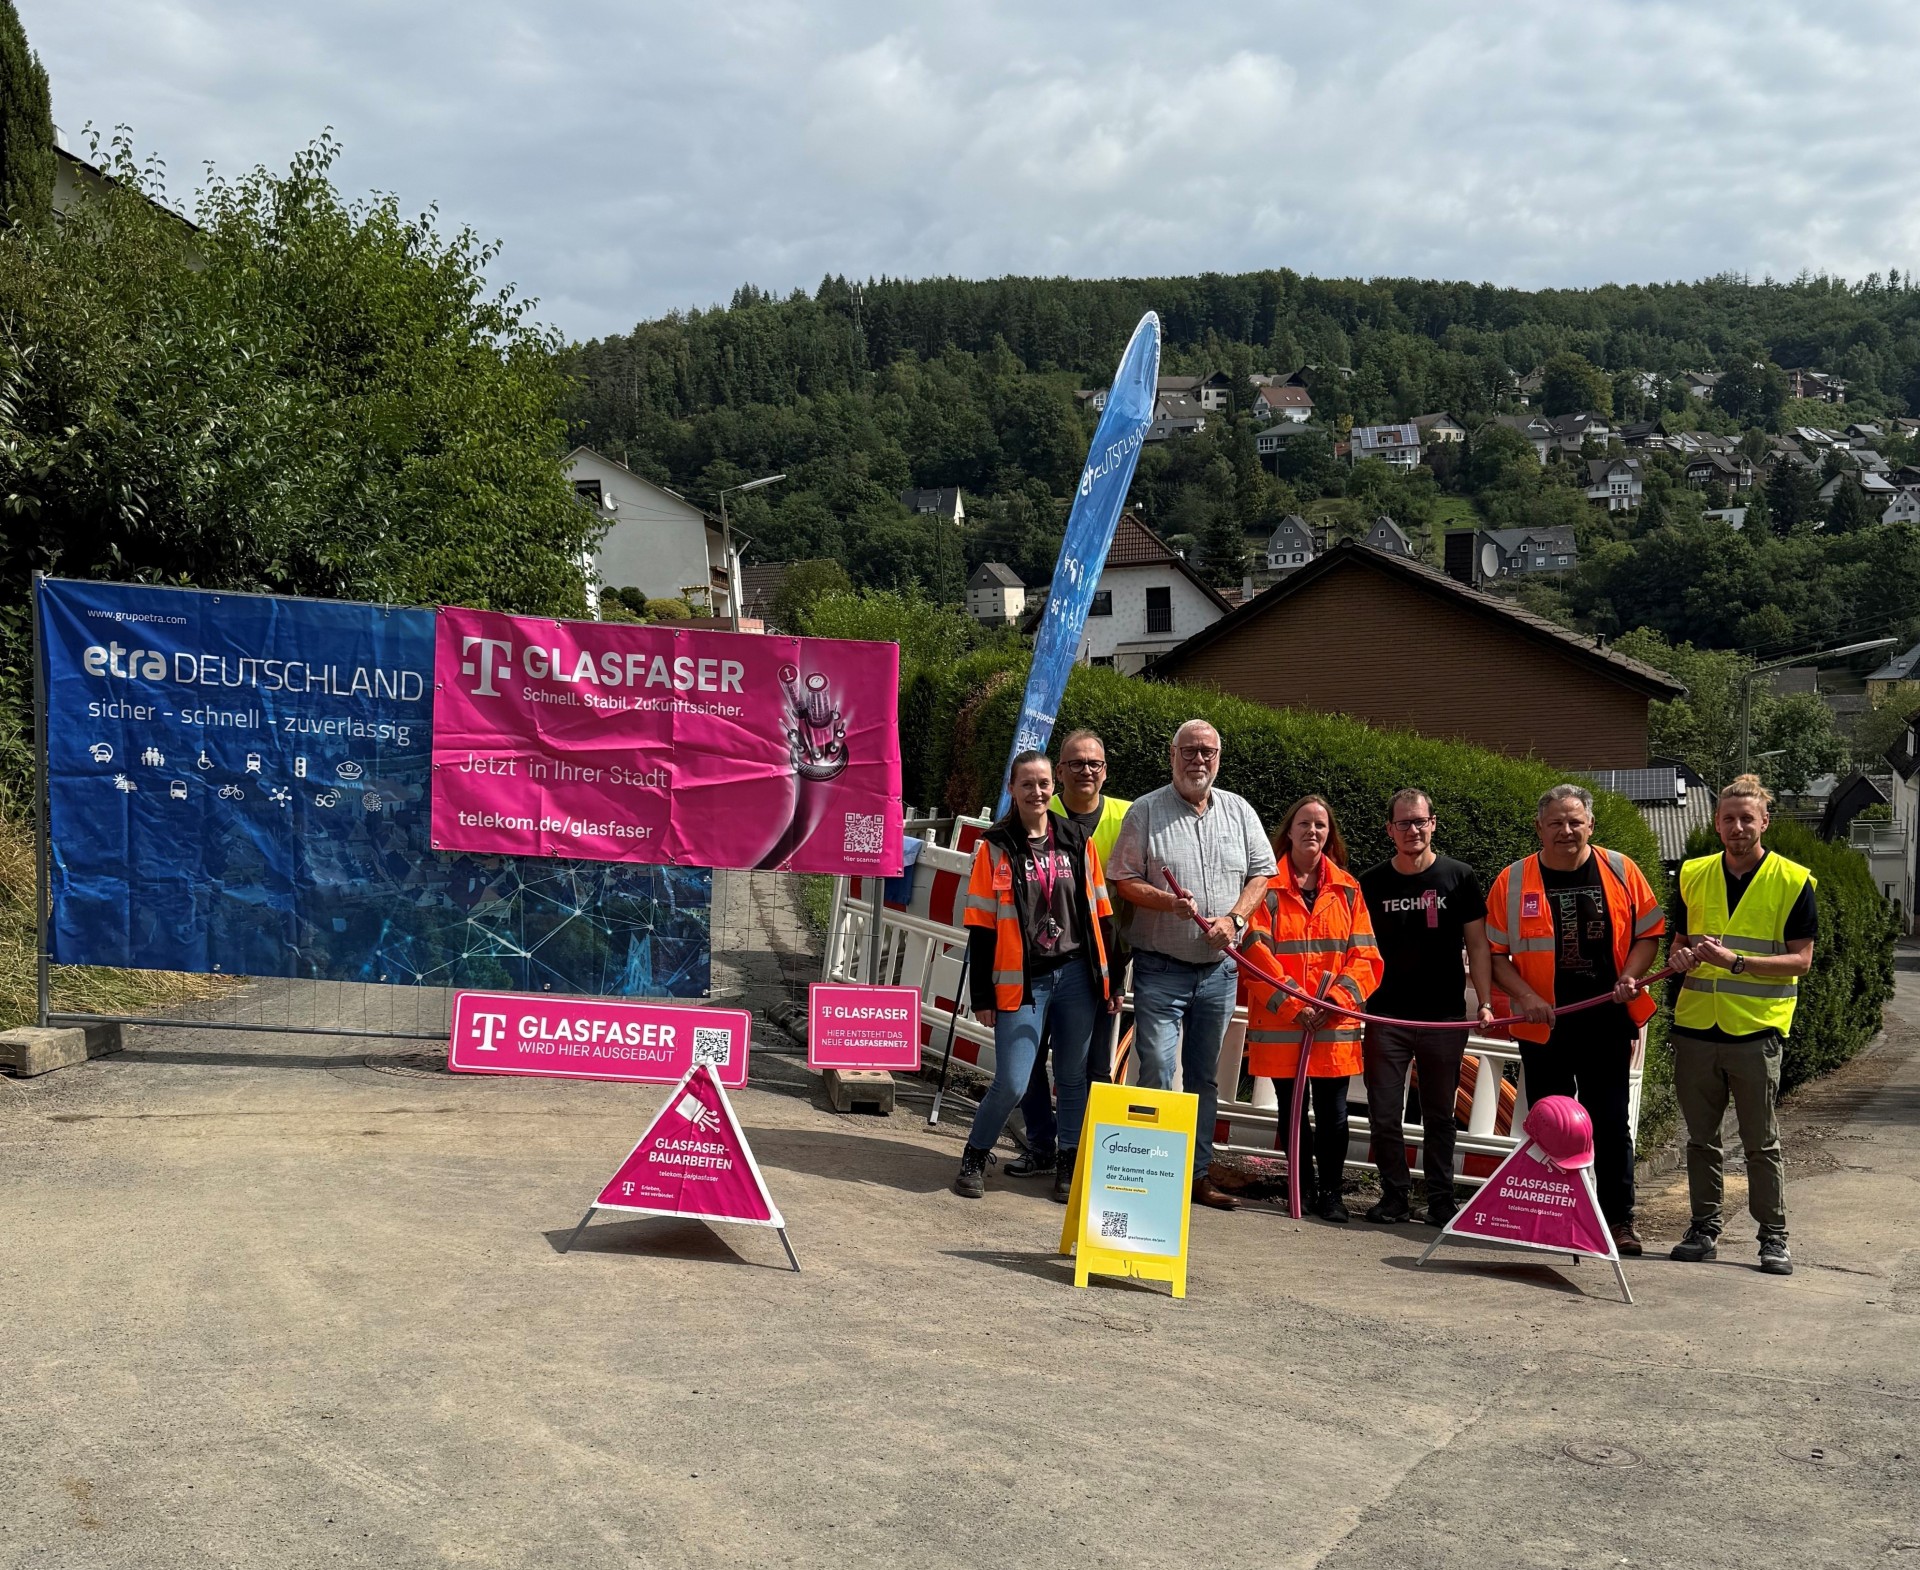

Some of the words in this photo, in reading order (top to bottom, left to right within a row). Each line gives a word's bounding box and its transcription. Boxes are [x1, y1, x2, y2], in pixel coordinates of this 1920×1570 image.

[87, 609, 187, 624] www.grupoetra.com
[83, 640, 167, 681] etra
[174, 652, 424, 702] DEUTSCHLAND
[522, 645, 745, 694] GLASFASER
[522, 687, 580, 706] Schnell.
[583, 693, 631, 710] Stabil.
[634, 697, 744, 717] Zukunftssicher.
[88, 698, 155, 721] sicher
[181, 705, 260, 729] schnell
[284, 716, 411, 747] zuverlässig
[459, 753, 517, 776] Jetzt
[529, 758, 547, 778] in
[554, 760, 603, 782] Ihrer
[609, 765, 668, 788] Stadt
[315, 794, 336, 808] 5G
[458, 810, 653, 839] telekom.de/glasfaser
[834, 1006, 908, 1020] GLASFASER
[518, 1015, 676, 1048] GLASFASER
[827, 1029, 845, 1037] HIER
[846, 1030, 886, 1038] ENTSTEHT
[887, 1031, 903, 1039] DAS
[517, 1041, 555, 1055] WIRD
[558, 1044, 589, 1058] HIER
[592, 1046, 674, 1063] AUSGEBAUT
[821, 1038, 842, 1046] NEUE
[844, 1039, 908, 1048] GLASFASERNETZ
[655, 1138, 730, 1155] GLASFASER-
[1109, 1141, 1169, 1158] glasfaserplus
[649, 1151, 732, 1170] BAUARBEITEN
[1106, 1164, 1120, 1172] Hier
[1121, 1165, 1145, 1175] kommt
[1146, 1168, 1158, 1176] das
[1159, 1170, 1175, 1178] Netz
[1106, 1172, 1117, 1180] der
[1118, 1174, 1144, 1183] Zukunft
[1506, 1175, 1574, 1194] GLASFASER-
[1499, 1187, 1577, 1207] BAUARBEITEN
